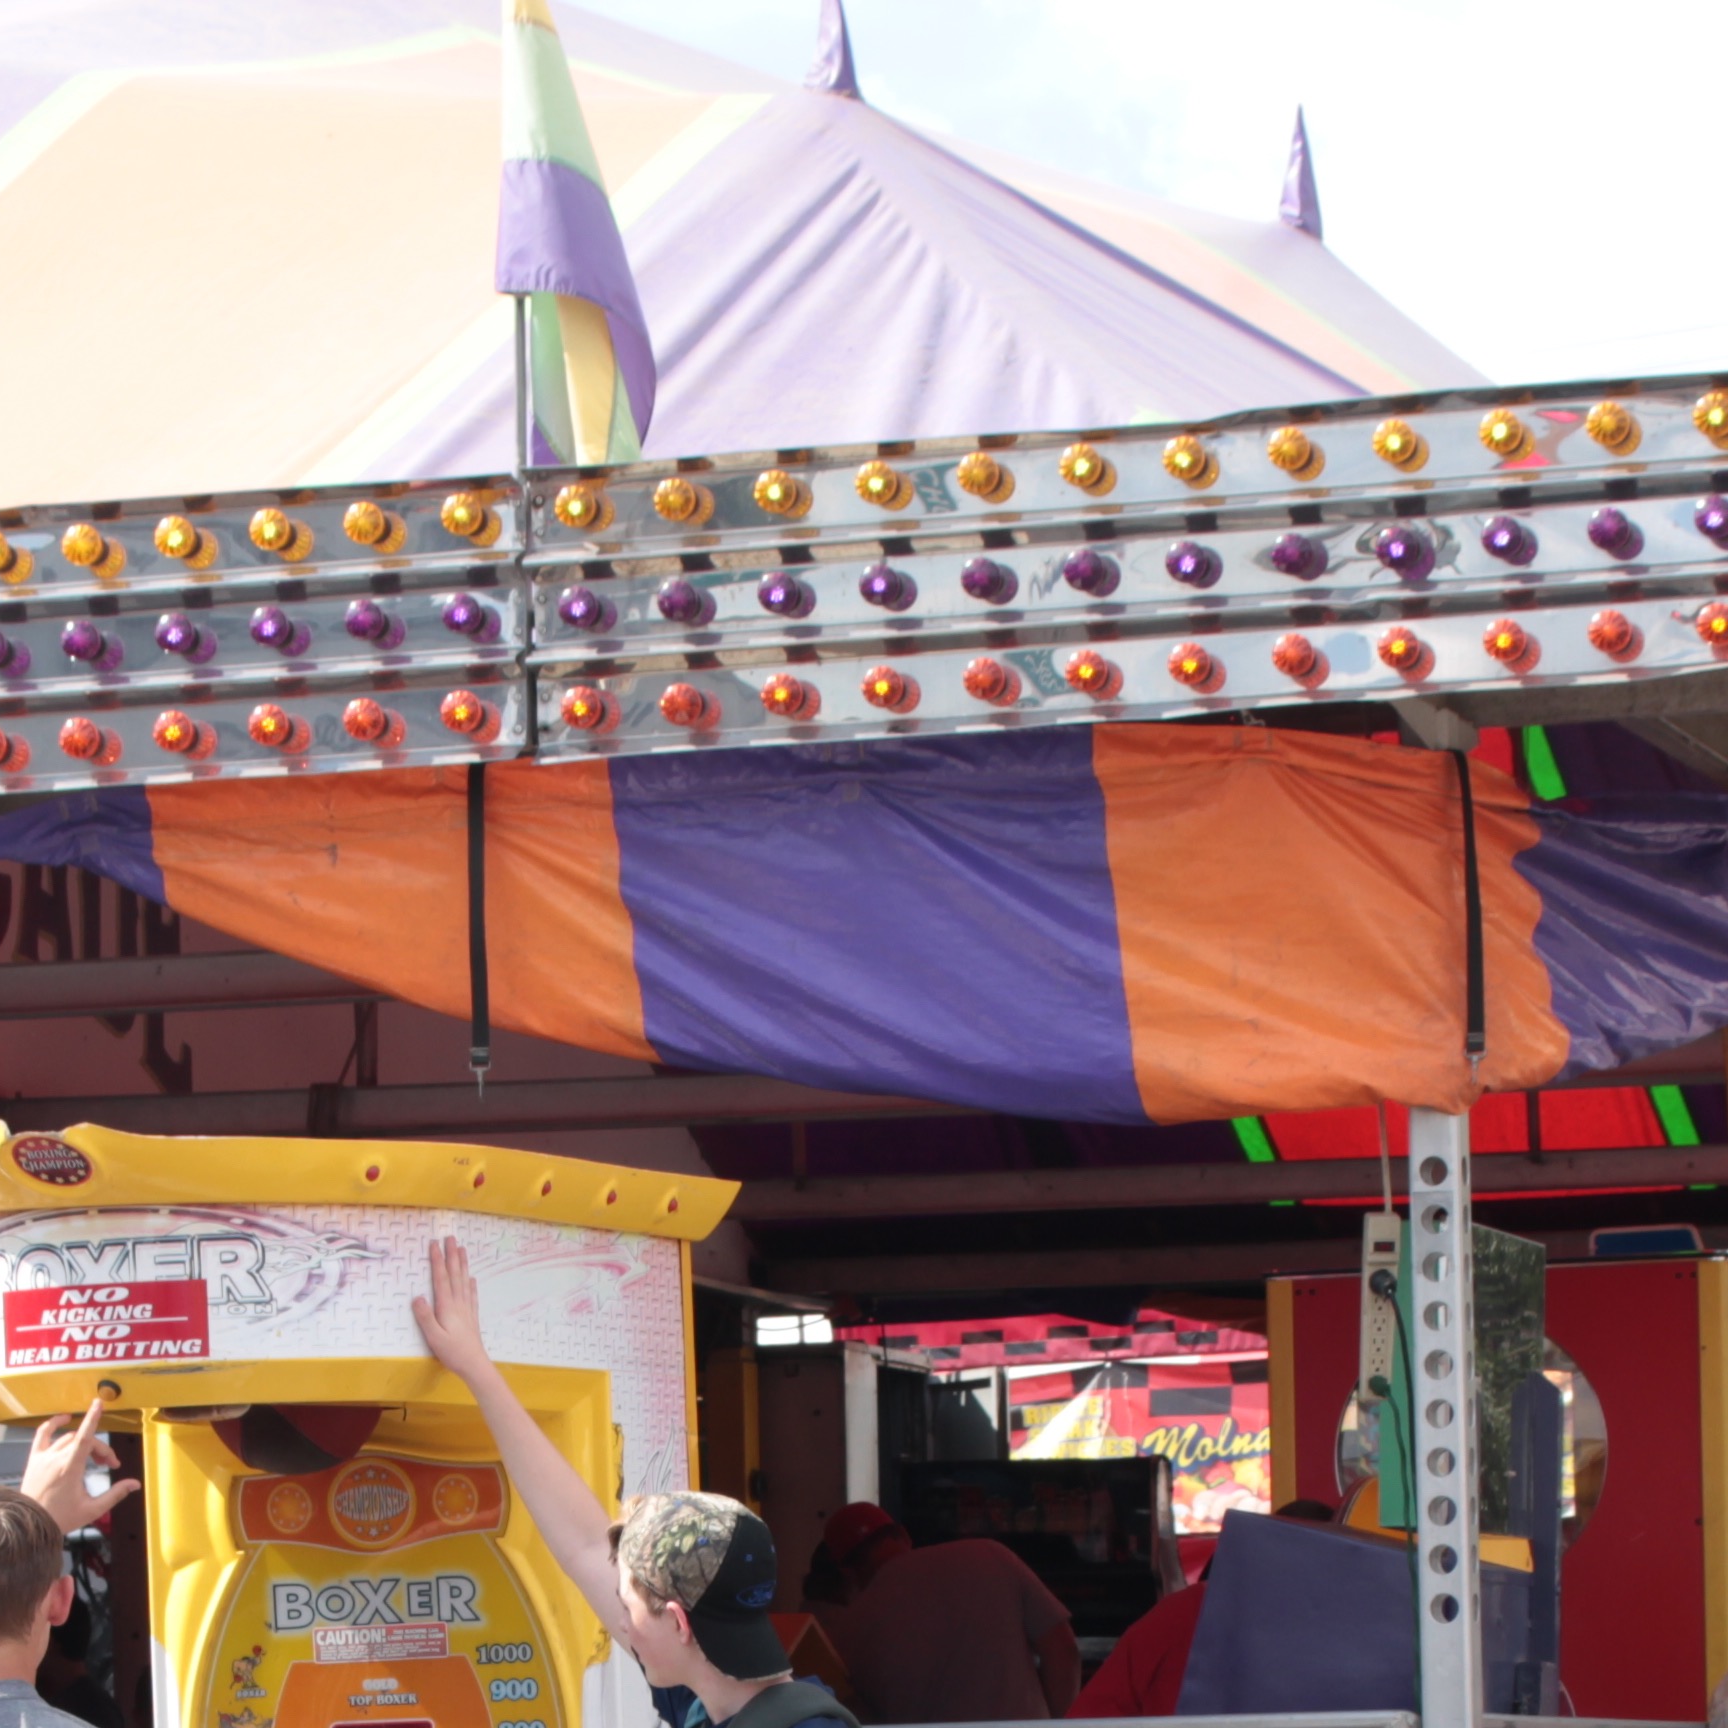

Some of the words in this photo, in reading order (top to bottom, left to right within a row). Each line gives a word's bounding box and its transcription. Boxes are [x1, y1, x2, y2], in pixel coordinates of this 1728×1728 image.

[26, 1148, 72, 1160] BOXING
[22, 1158, 85, 1171] CHAMPION
[58, 1286, 130, 1305] NO
[40, 1303, 154, 1325] KICKING
[60, 1323, 132, 1342] NO
[9, 1345, 70, 1365] HEAD
[75, 1338, 203, 1361] BUTTING
[335, 1484, 411, 1521] CHAMPIONSHIP
[272, 1575, 481, 1632] BOXER
[316, 1628, 387, 1646] CAUTION!
[476, 1643, 533, 1664] 1000
[349, 1695, 373, 1706] TOP
[376, 1693, 418, 1705] BOXER
[489, 1678, 538, 1701] 900
